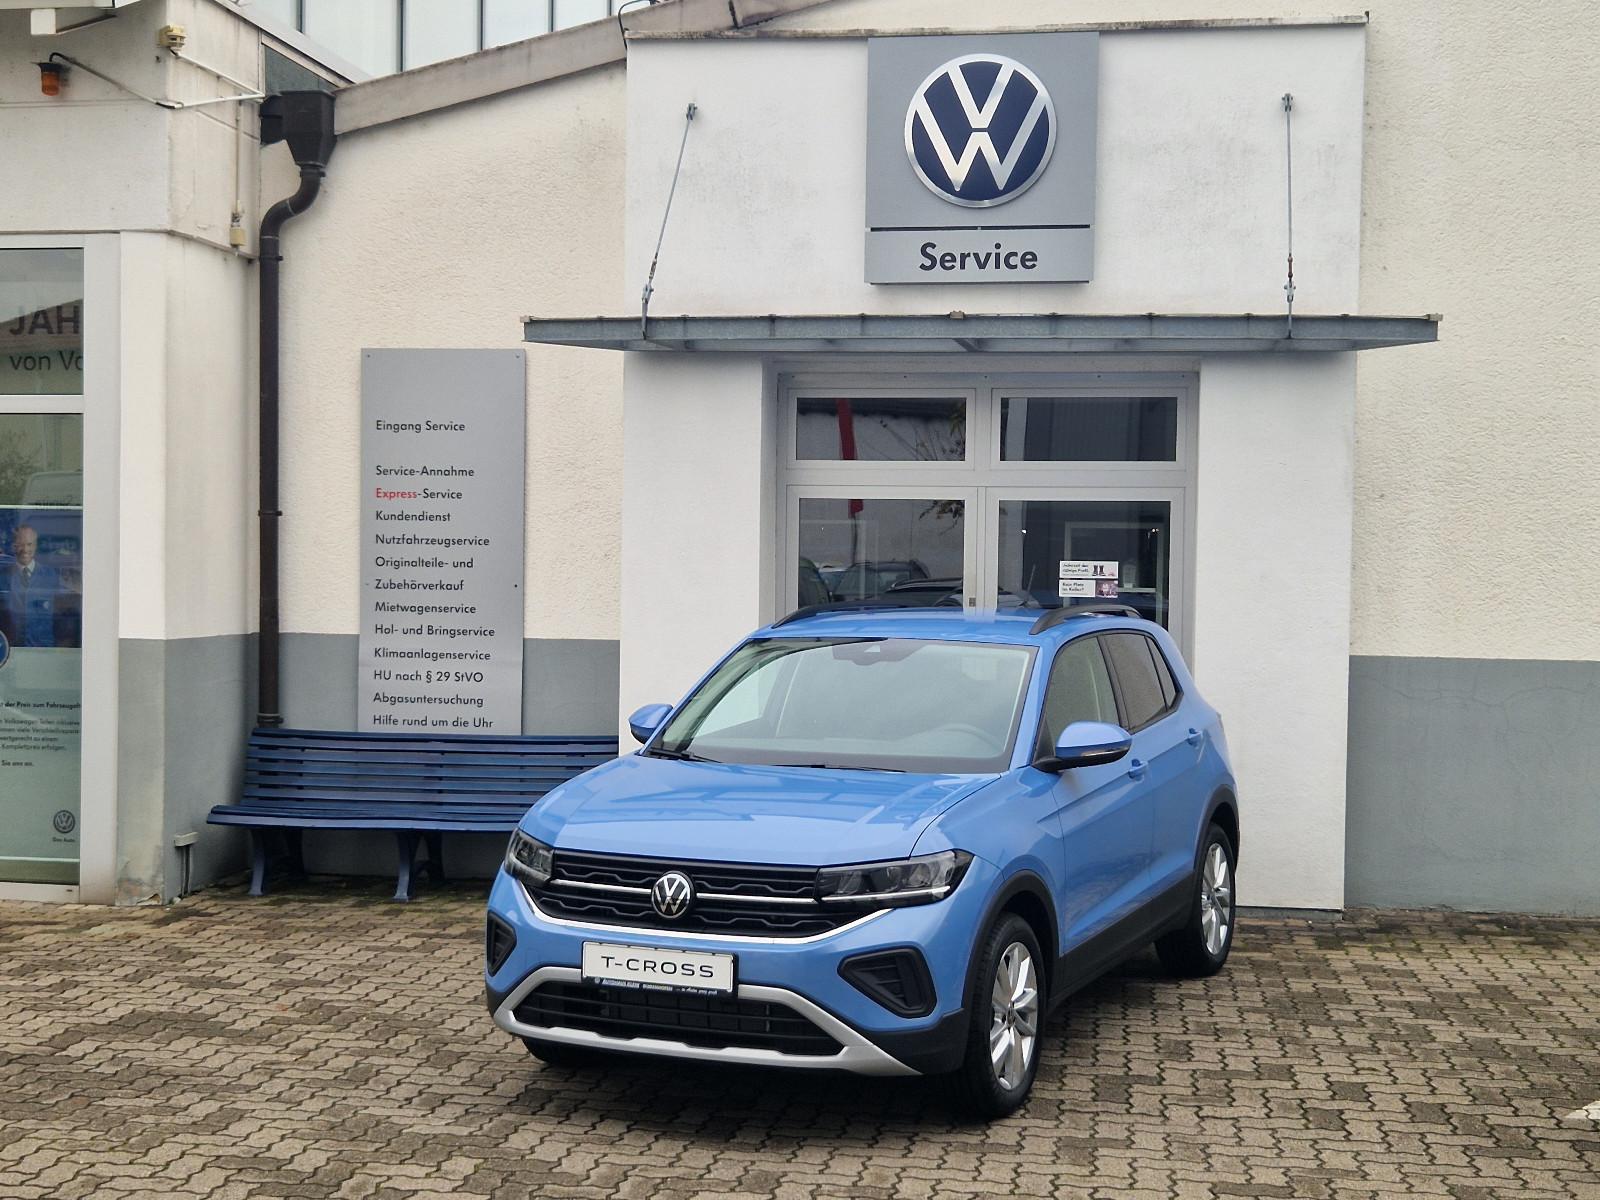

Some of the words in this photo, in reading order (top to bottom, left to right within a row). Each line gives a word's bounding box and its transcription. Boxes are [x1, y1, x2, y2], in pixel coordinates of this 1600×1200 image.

[919, 241, 1038, 271] Service
[9, 355, 51, 371] von
[376, 420, 422, 433] Eingang
[425, 421, 466, 431] Service
[376, 465, 475, 477] Service-Annahme
[376, 488, 463, 500] Express-Service
[375, 510, 451, 522] Kundendienst
[375, 533, 490, 548] Nutzfahrzeugservice
[375, 556, 449, 570] Originalteile-
[453, 558, 474, 569] und
[375, 578, 465, 591] Zubehörverkauf
[375, 602, 477, 615] Mietwagenservice
[375, 624, 399, 635] Hol-
[402, 624, 423, 635] und
[427, 625, 496, 639] Bringservice
[374, 648, 491, 662] Klimaanlagenservice
[374, 670, 392, 681] HU
[395, 671, 422, 681] nach
[426, 671, 432, 683] §
[436, 671, 451, 682] 29
[454, 672, 484, 683] StVO
[373, 692, 484, 708] Abgasuntersuchung
[373, 714, 399, 726] Hilfe
[402, 716, 428, 727] rund
[452, 717, 469, 728] die
[473, 717, 494, 729] Uhr
[601, 955, 714, 978] T-CROSS
